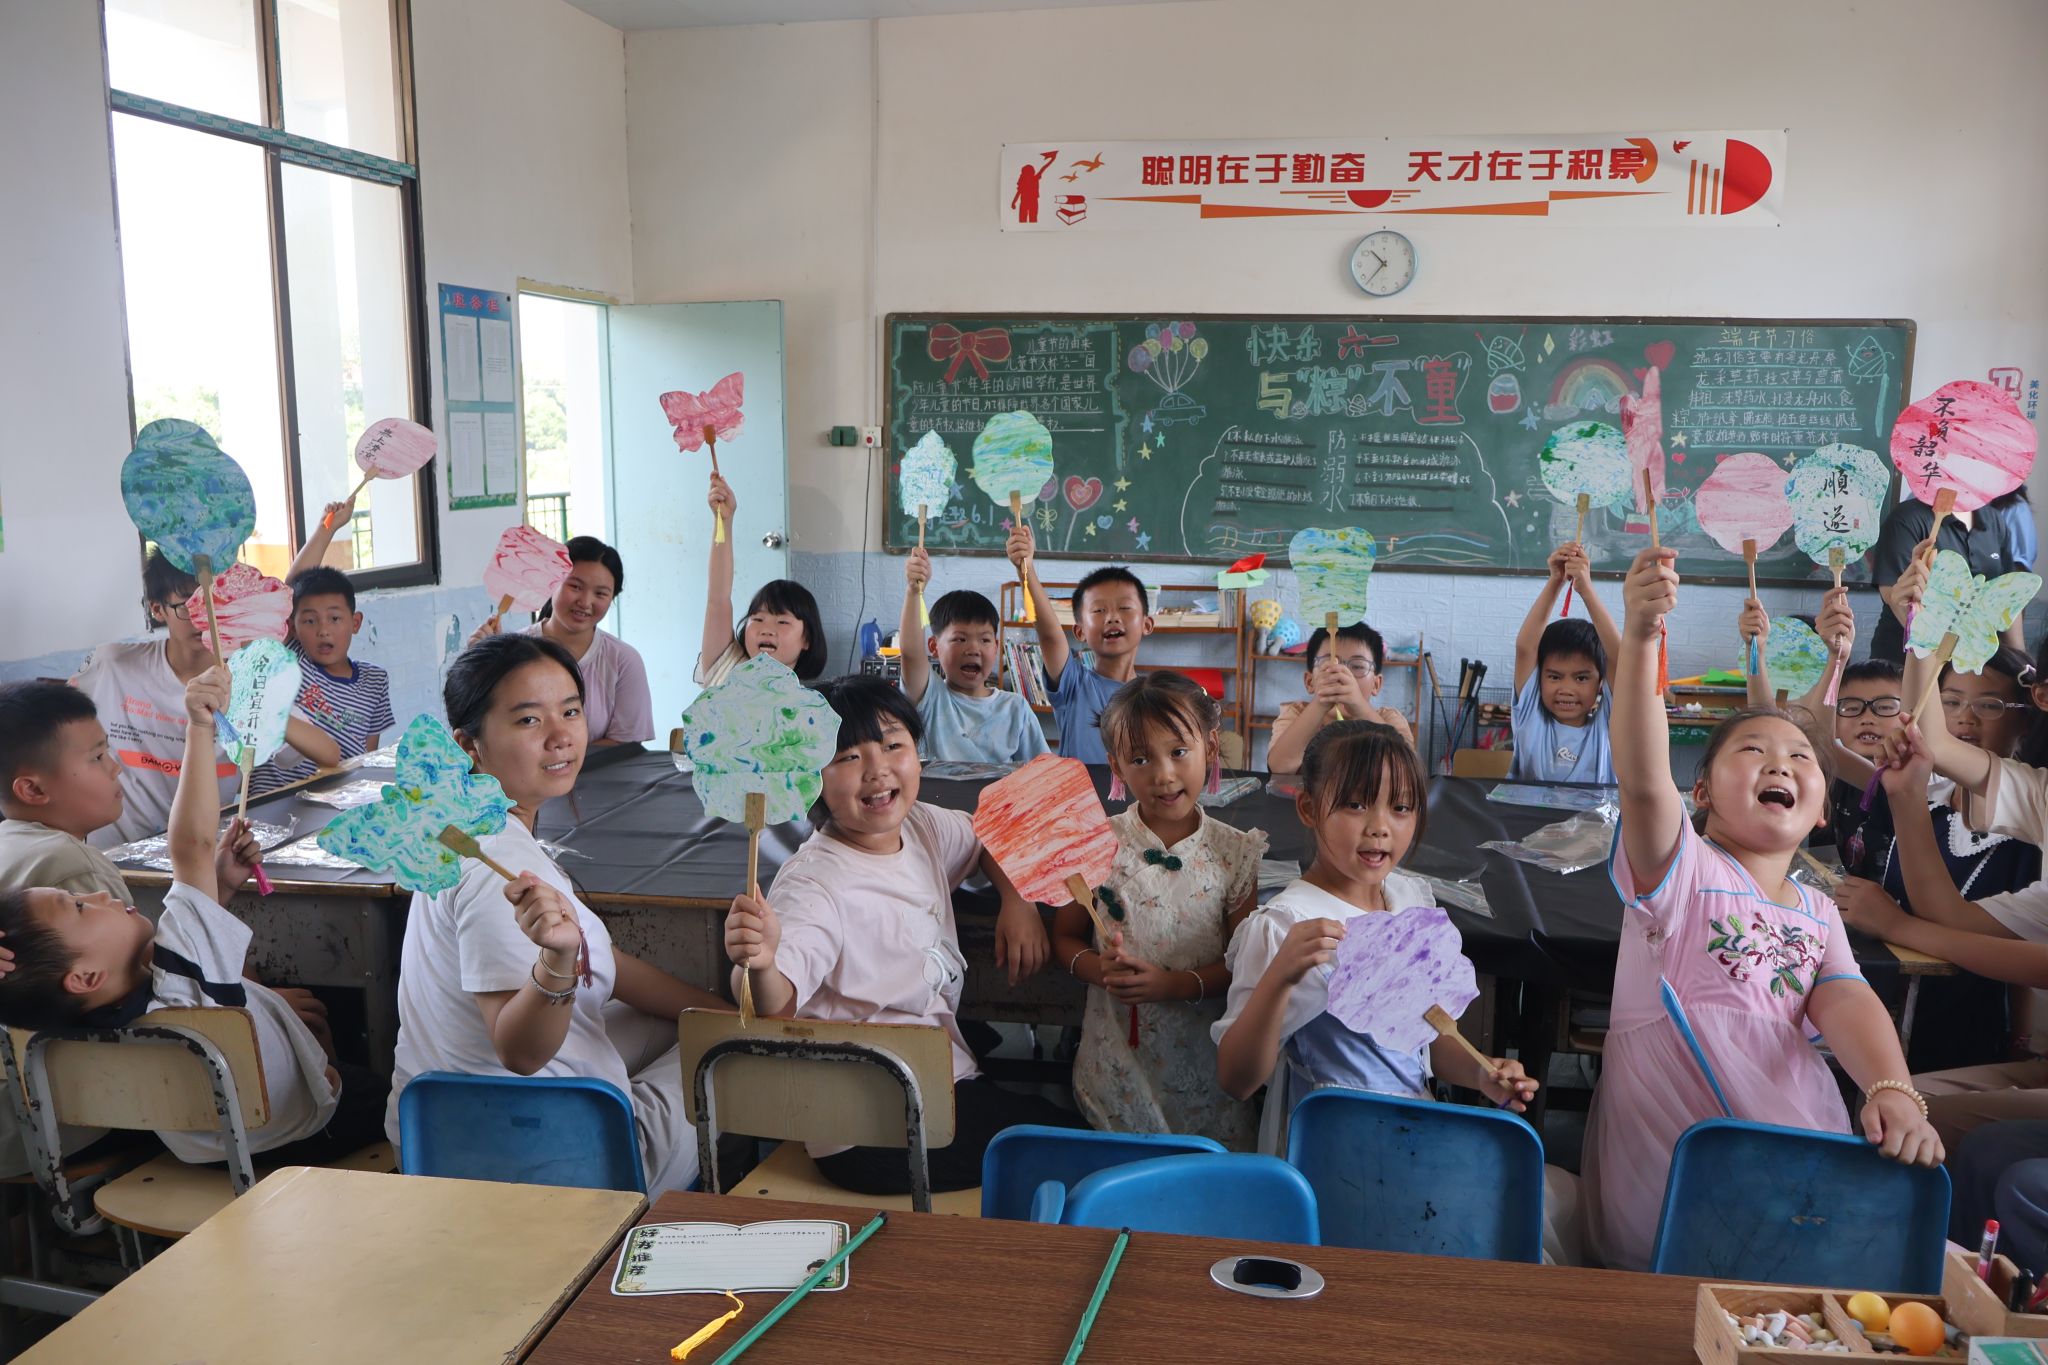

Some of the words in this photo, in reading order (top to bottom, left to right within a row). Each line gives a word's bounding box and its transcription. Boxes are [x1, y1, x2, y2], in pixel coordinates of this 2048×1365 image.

[1142, 153, 1366, 185] 聪明在于勤奋
[1408, 147, 1645, 183] 天才在于积累
[1027, 336, 1093, 353] 儿童节的由来
[1719, 328, 1816, 349] 端午节习俗
[2026, 380, 2040, 420] 美化环境
[1910, 397, 1956, 487] 不负韶华
[1320, 429, 1347, 513] 防溺水
